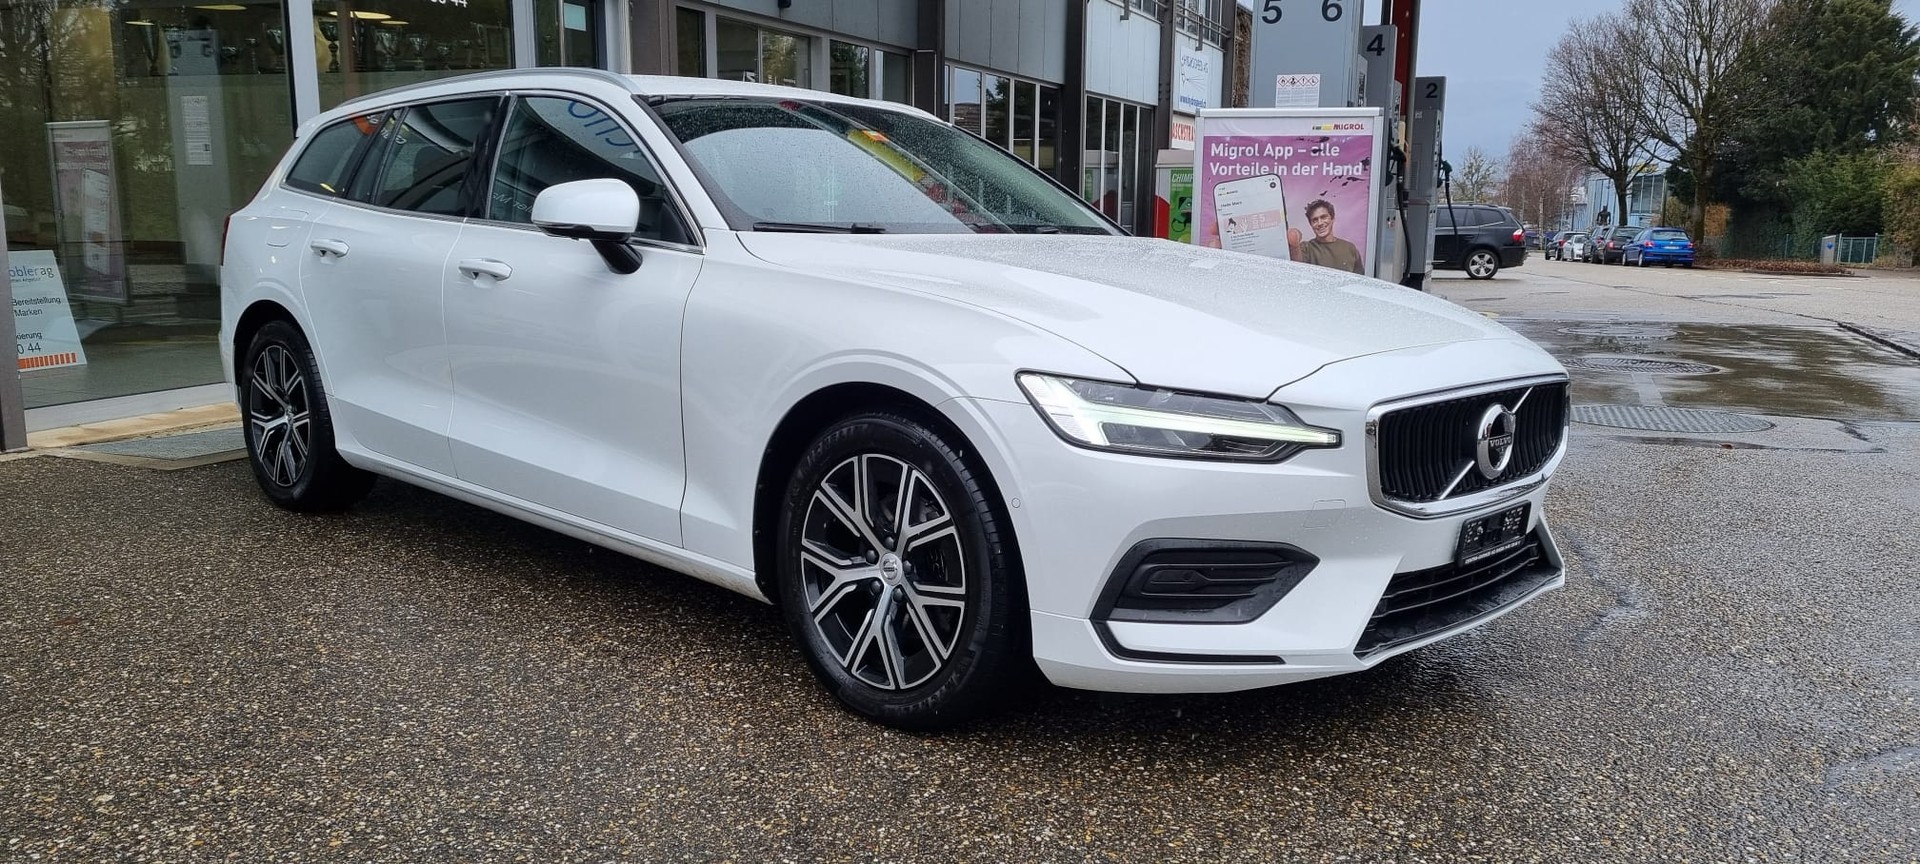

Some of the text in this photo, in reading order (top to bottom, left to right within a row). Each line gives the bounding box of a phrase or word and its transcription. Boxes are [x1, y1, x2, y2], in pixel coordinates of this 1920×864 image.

[1262, 0, 1282, 24] 5
[1321, 0, 1342, 22] 6
[1366, 34, 1385, 56] 4
[1425, 82, 1438, 98] 2
[1211, 143, 1260, 160] Migrol
[1263, 143, 1293, 160] App
[1310, 143, 1340, 157] alle
[1209, 162, 1363, 176] Vorteile in der Hand
[40, 267, 54, 278] ag
[27, 342, 42, 353] 44
[1489, 436, 1512, 447] VOLVO
